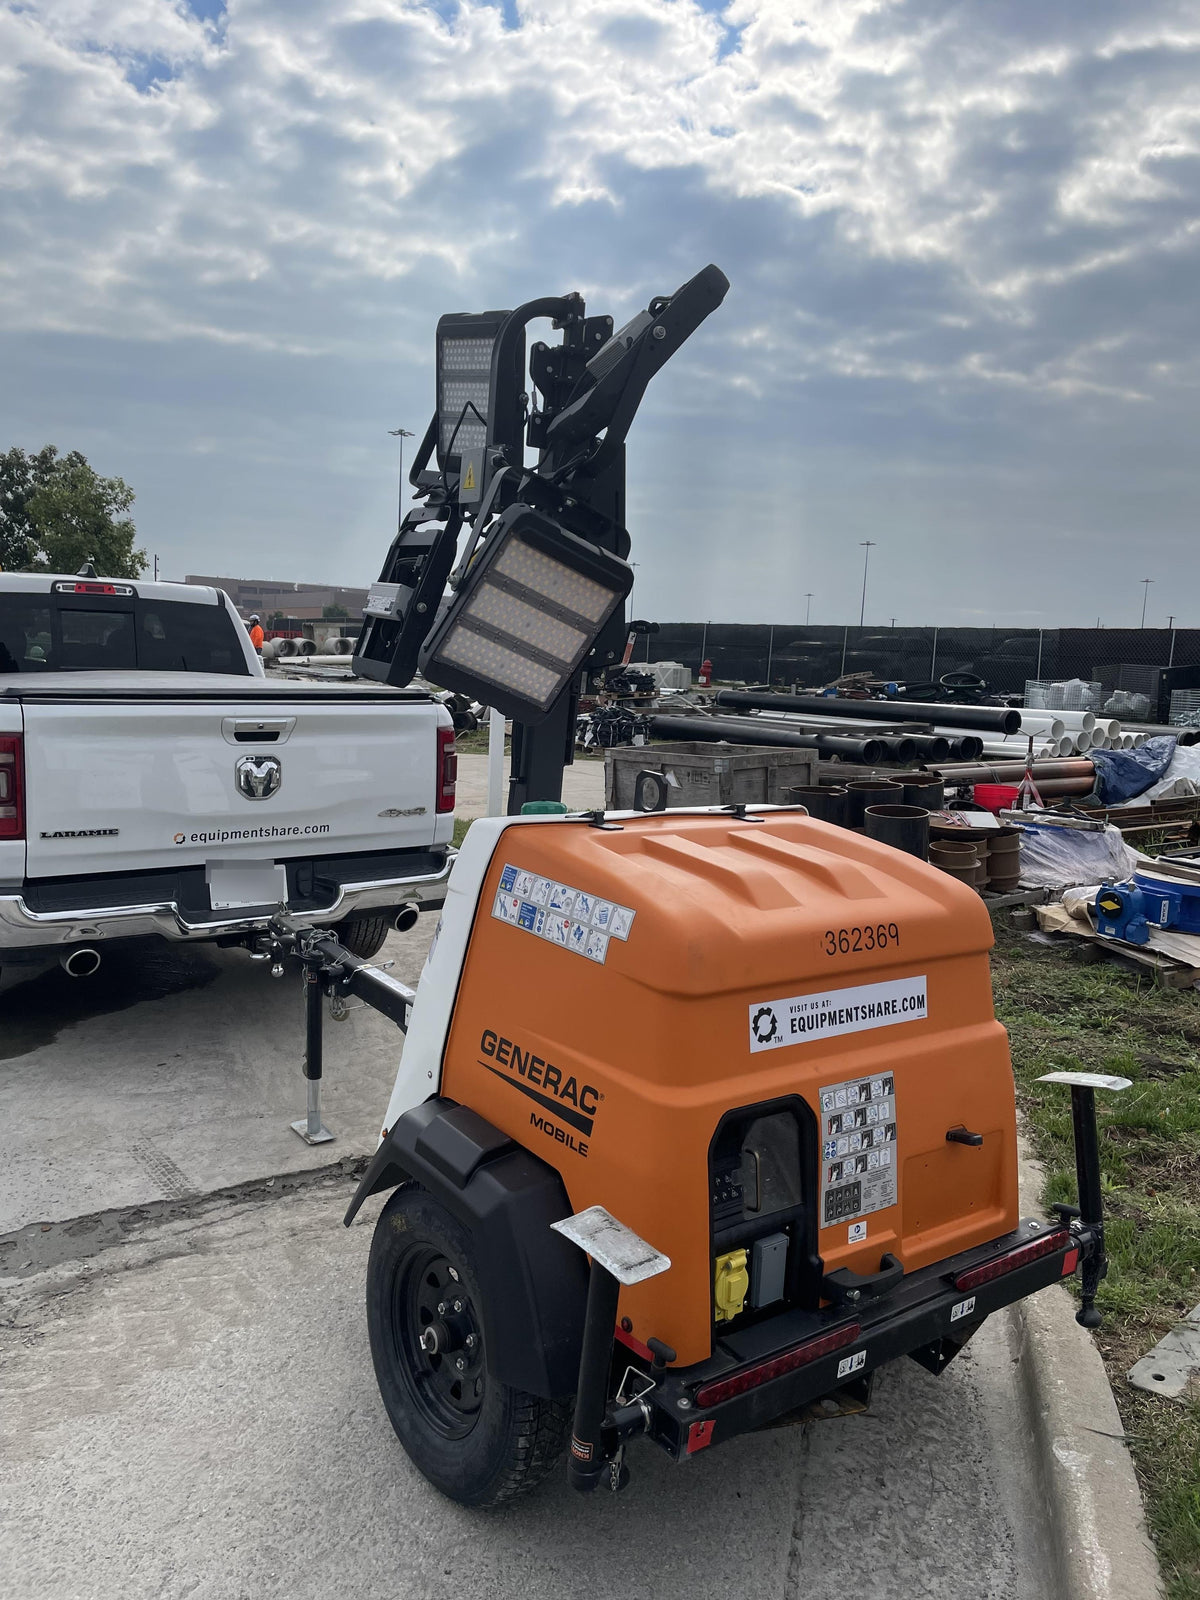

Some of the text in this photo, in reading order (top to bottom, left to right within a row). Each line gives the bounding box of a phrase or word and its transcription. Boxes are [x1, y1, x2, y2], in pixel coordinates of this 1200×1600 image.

[40, 828, 119, 840] LARAMIE
[190, 822, 330, 843] equipmentshare.com
[825, 922, 900, 956] 362369
[789, 999, 832, 1014] VISIT US AT:
[790, 994, 925, 1034] EQUIPMENTSHARE.COM
[530, 1112, 589, 1158] MOBILE
